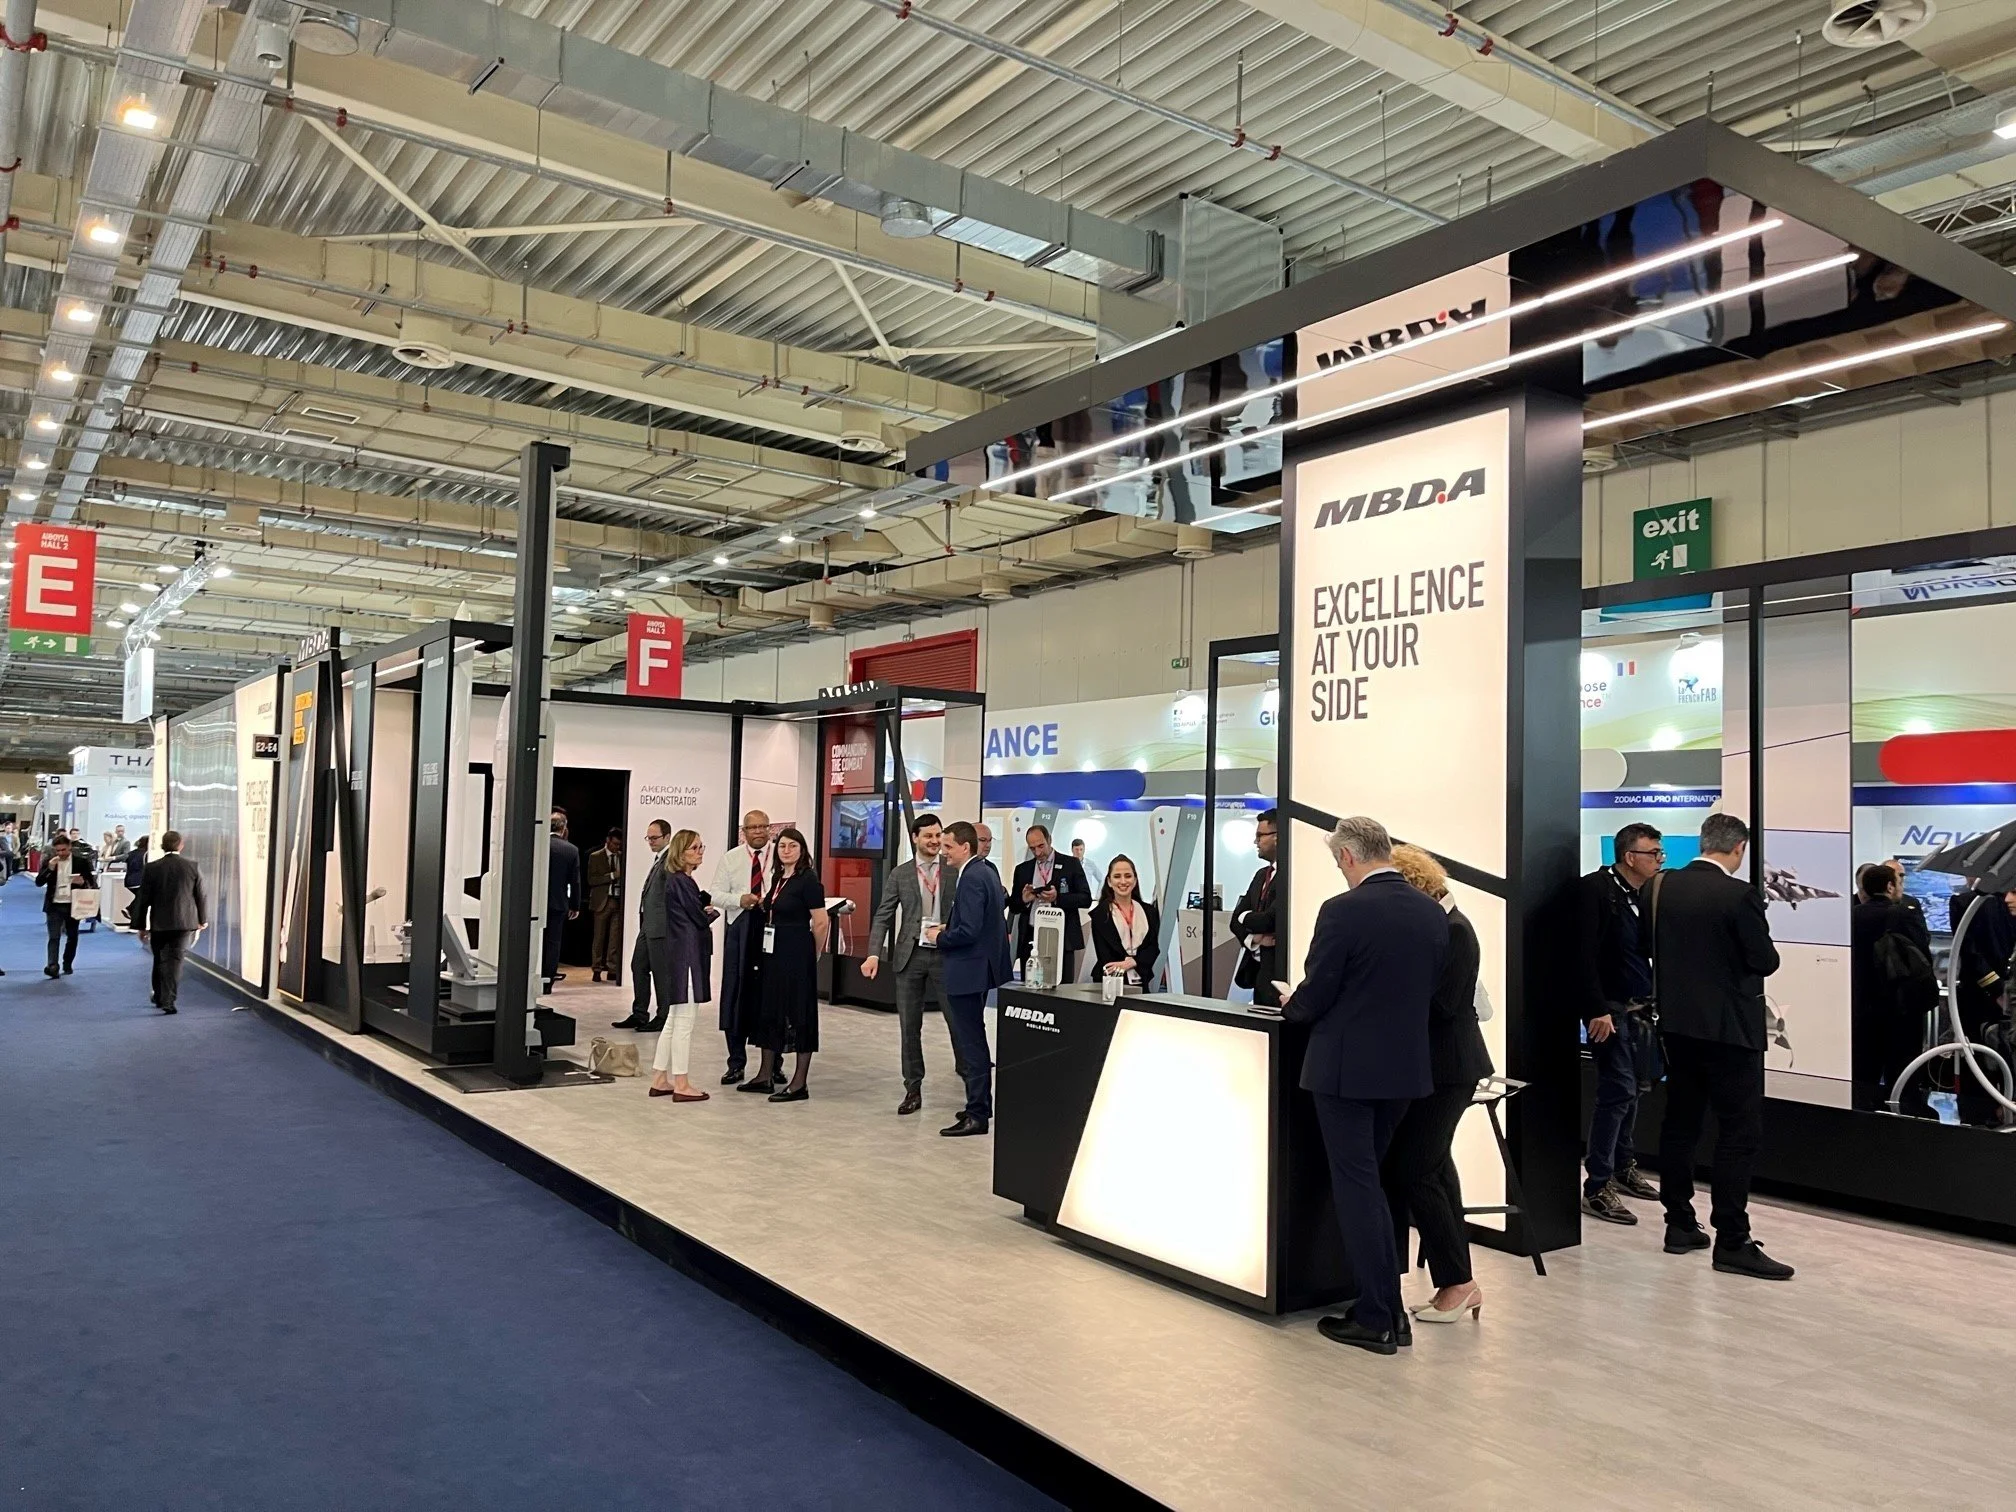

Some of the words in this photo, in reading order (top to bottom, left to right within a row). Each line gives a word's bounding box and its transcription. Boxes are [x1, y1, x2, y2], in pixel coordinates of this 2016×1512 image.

[1314, 467, 1486, 530] MBDA
[1643, 508, 1699, 538] exit
[41, 540, 61, 549] HALL
[26, 554, 78, 617] E
[1313, 561, 1485, 629] EXCELLENCE
[1311, 632, 1341, 675] AT
[1347, 623, 1419, 671] YOUR
[639, 639, 671, 686] F
[1580, 681, 1606, 693] ose
[1701, 687, 1717, 702] FAB
[1311, 677, 1368, 723] SIDE
[1260, 710, 1280, 726] GI
[255, 741, 278, 752] E2-E4
[832, 743, 867, 758] COMMANDING
[831, 758, 841, 772] THE
[842, 757, 863, 771] COMBAT
[831, 772, 844, 786] ZONE
[641, 785, 682, 793] AKERON
[685, 786, 701, 794] MP
[640, 795, 697, 806] DEMONSTRATOR
[1642, 795, 1671, 803] MILPRO
[1900, 825, 1992, 846] Nov
[1004, 1005, 1055, 1025] MBDA
